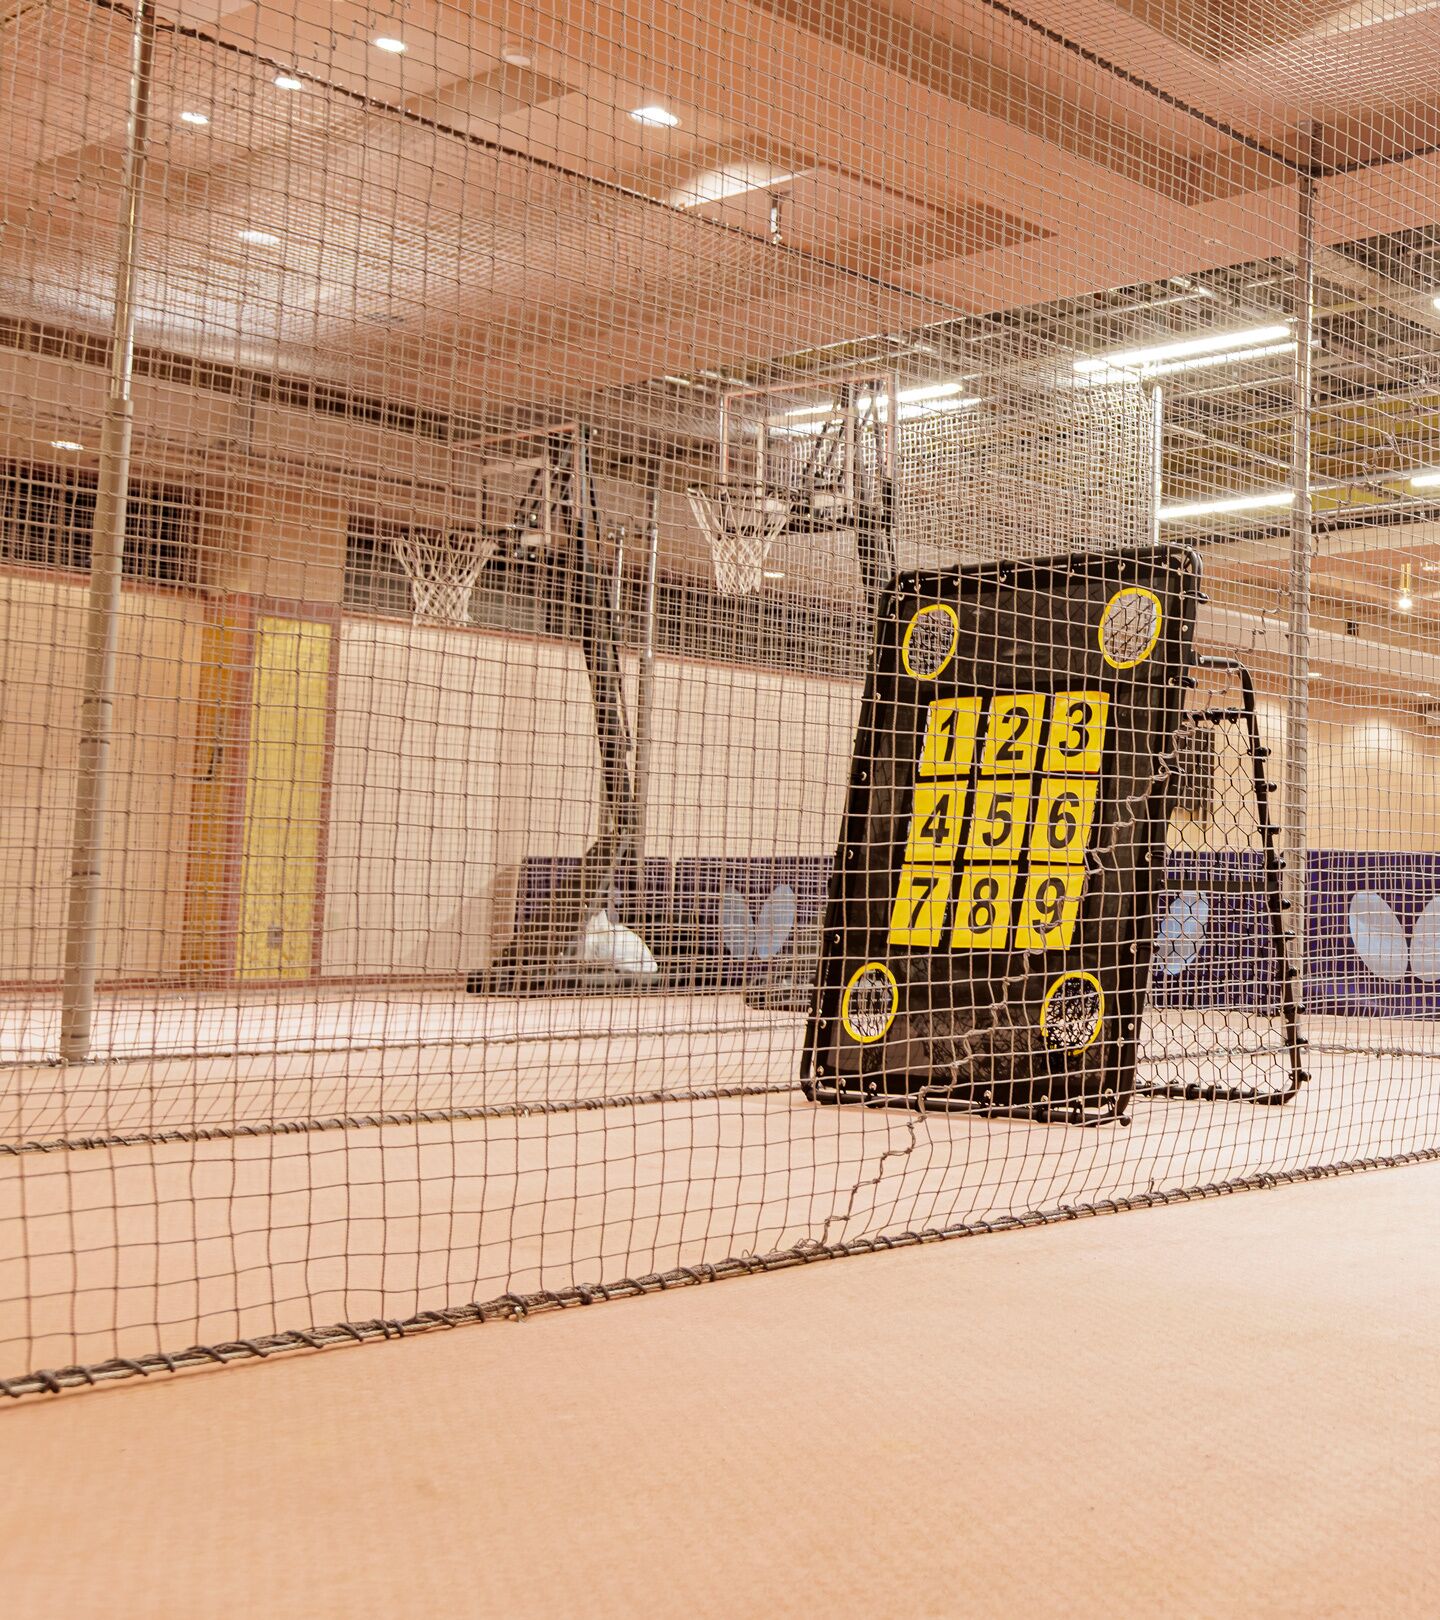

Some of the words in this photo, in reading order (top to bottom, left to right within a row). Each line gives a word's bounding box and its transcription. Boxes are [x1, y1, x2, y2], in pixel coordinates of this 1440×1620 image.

[941, 710, 960, 762] 1
[996, 706, 1030, 761] 2
[1059, 702, 1093, 757] 3
[920, 794, 950, 848] 4
[982, 792, 1014, 847] 5
[1047, 792, 1080, 849] 6
[908, 877, 939, 930] 7
[968, 877, 999, 934] 8
[1032, 877, 1066, 935] 9
